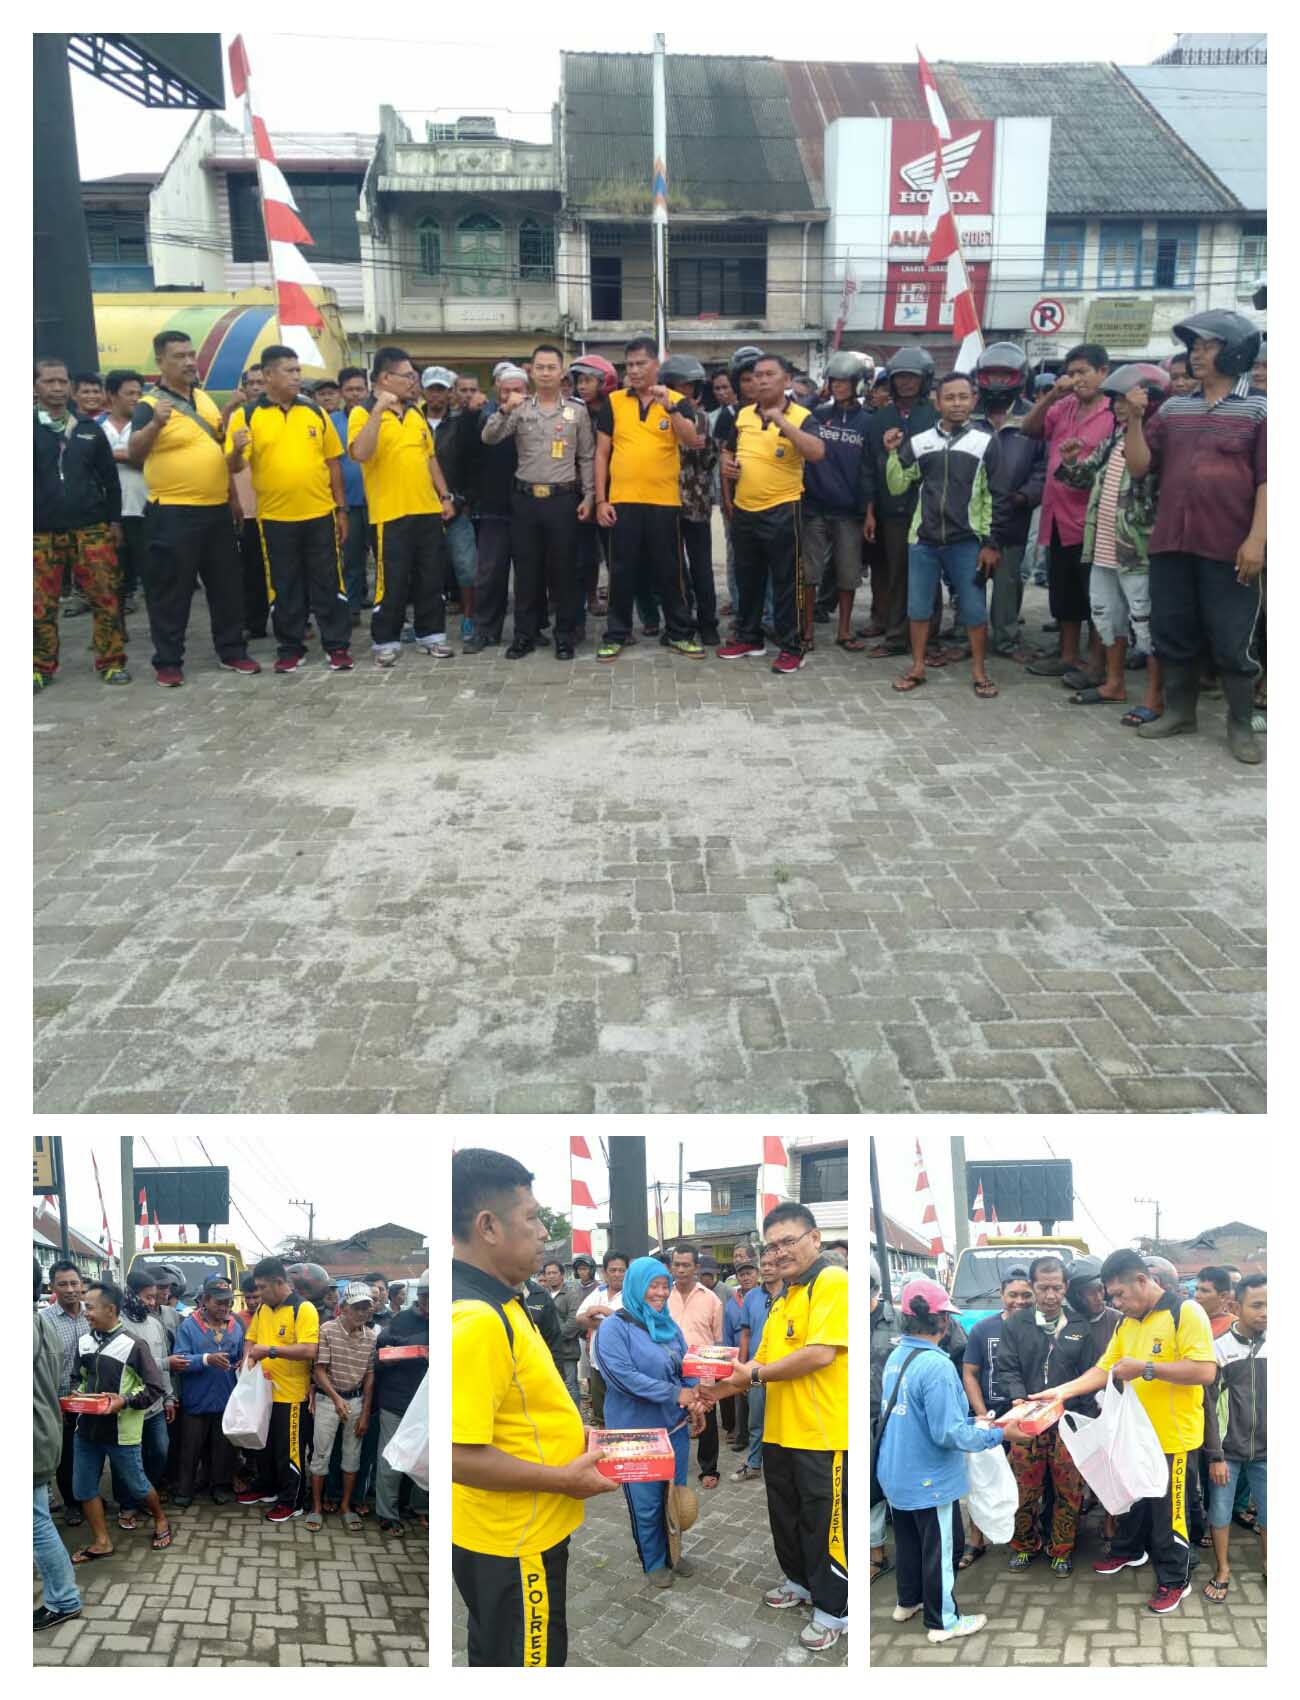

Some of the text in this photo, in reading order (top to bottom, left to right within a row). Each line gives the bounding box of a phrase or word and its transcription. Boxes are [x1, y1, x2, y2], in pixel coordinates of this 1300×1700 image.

[899, 191, 981, 203] HODA
[831, 1466, 841, 1543] POLRESTA
[527, 1573, 543, 1666] POLRES
